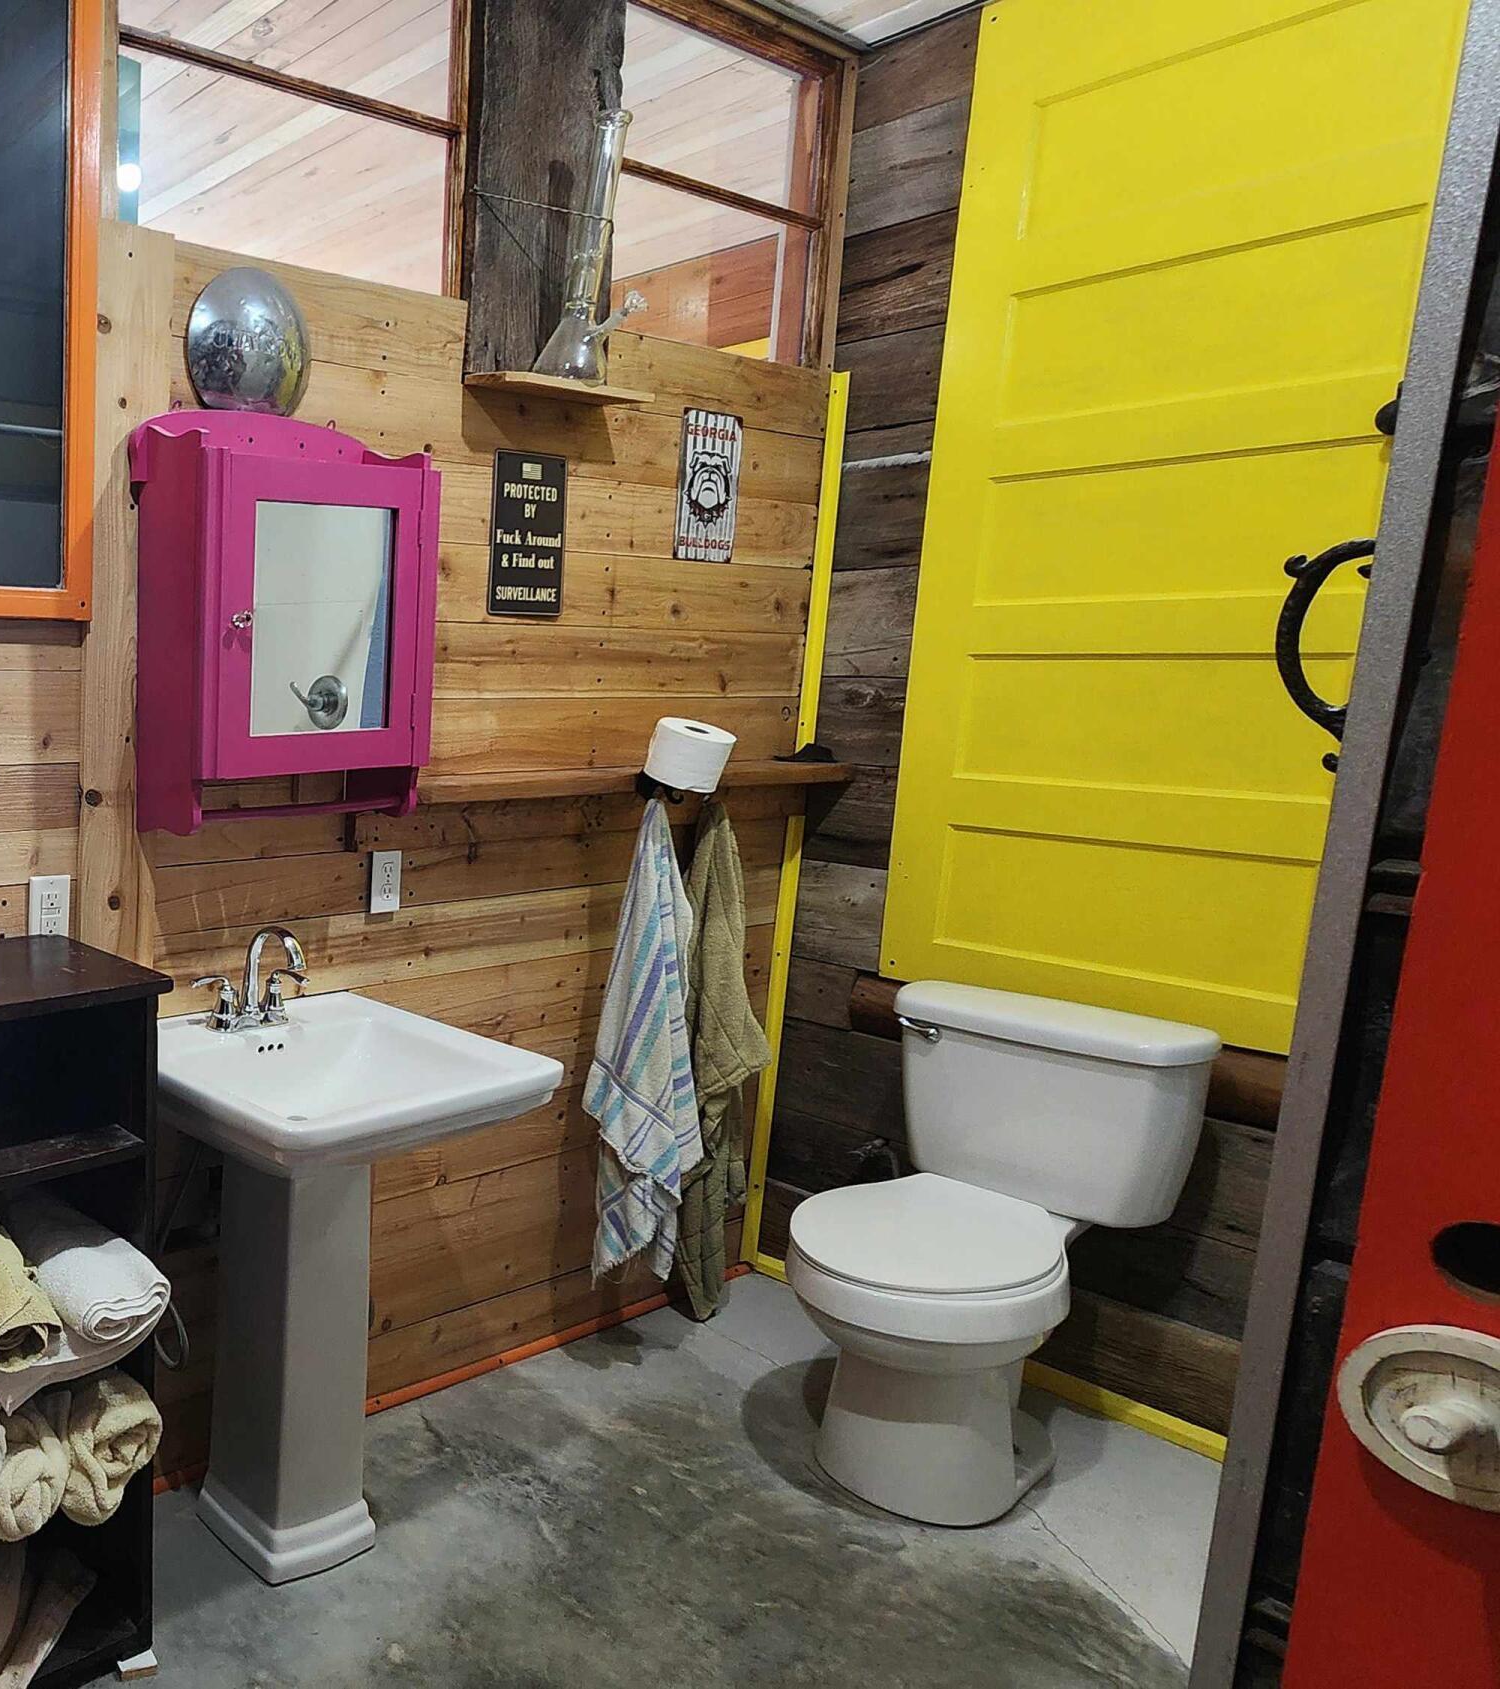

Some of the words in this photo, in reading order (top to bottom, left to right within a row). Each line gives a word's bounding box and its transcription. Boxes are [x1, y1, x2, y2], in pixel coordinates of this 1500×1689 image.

[687, 424, 737, 442] GEORGIA
[503, 483, 558, 502] PROTECTED
[524, 504, 537, 518] BY
[495, 529, 522, 545] Fuck
[524, 531, 562, 548] Around
[679, 536, 730, 551] BULLDOGS
[501, 553, 509, 567] &
[512, 552, 535, 568] Find
[537, 557, 555, 569] out
[495, 585, 557, 602] SURVEILLANCE
